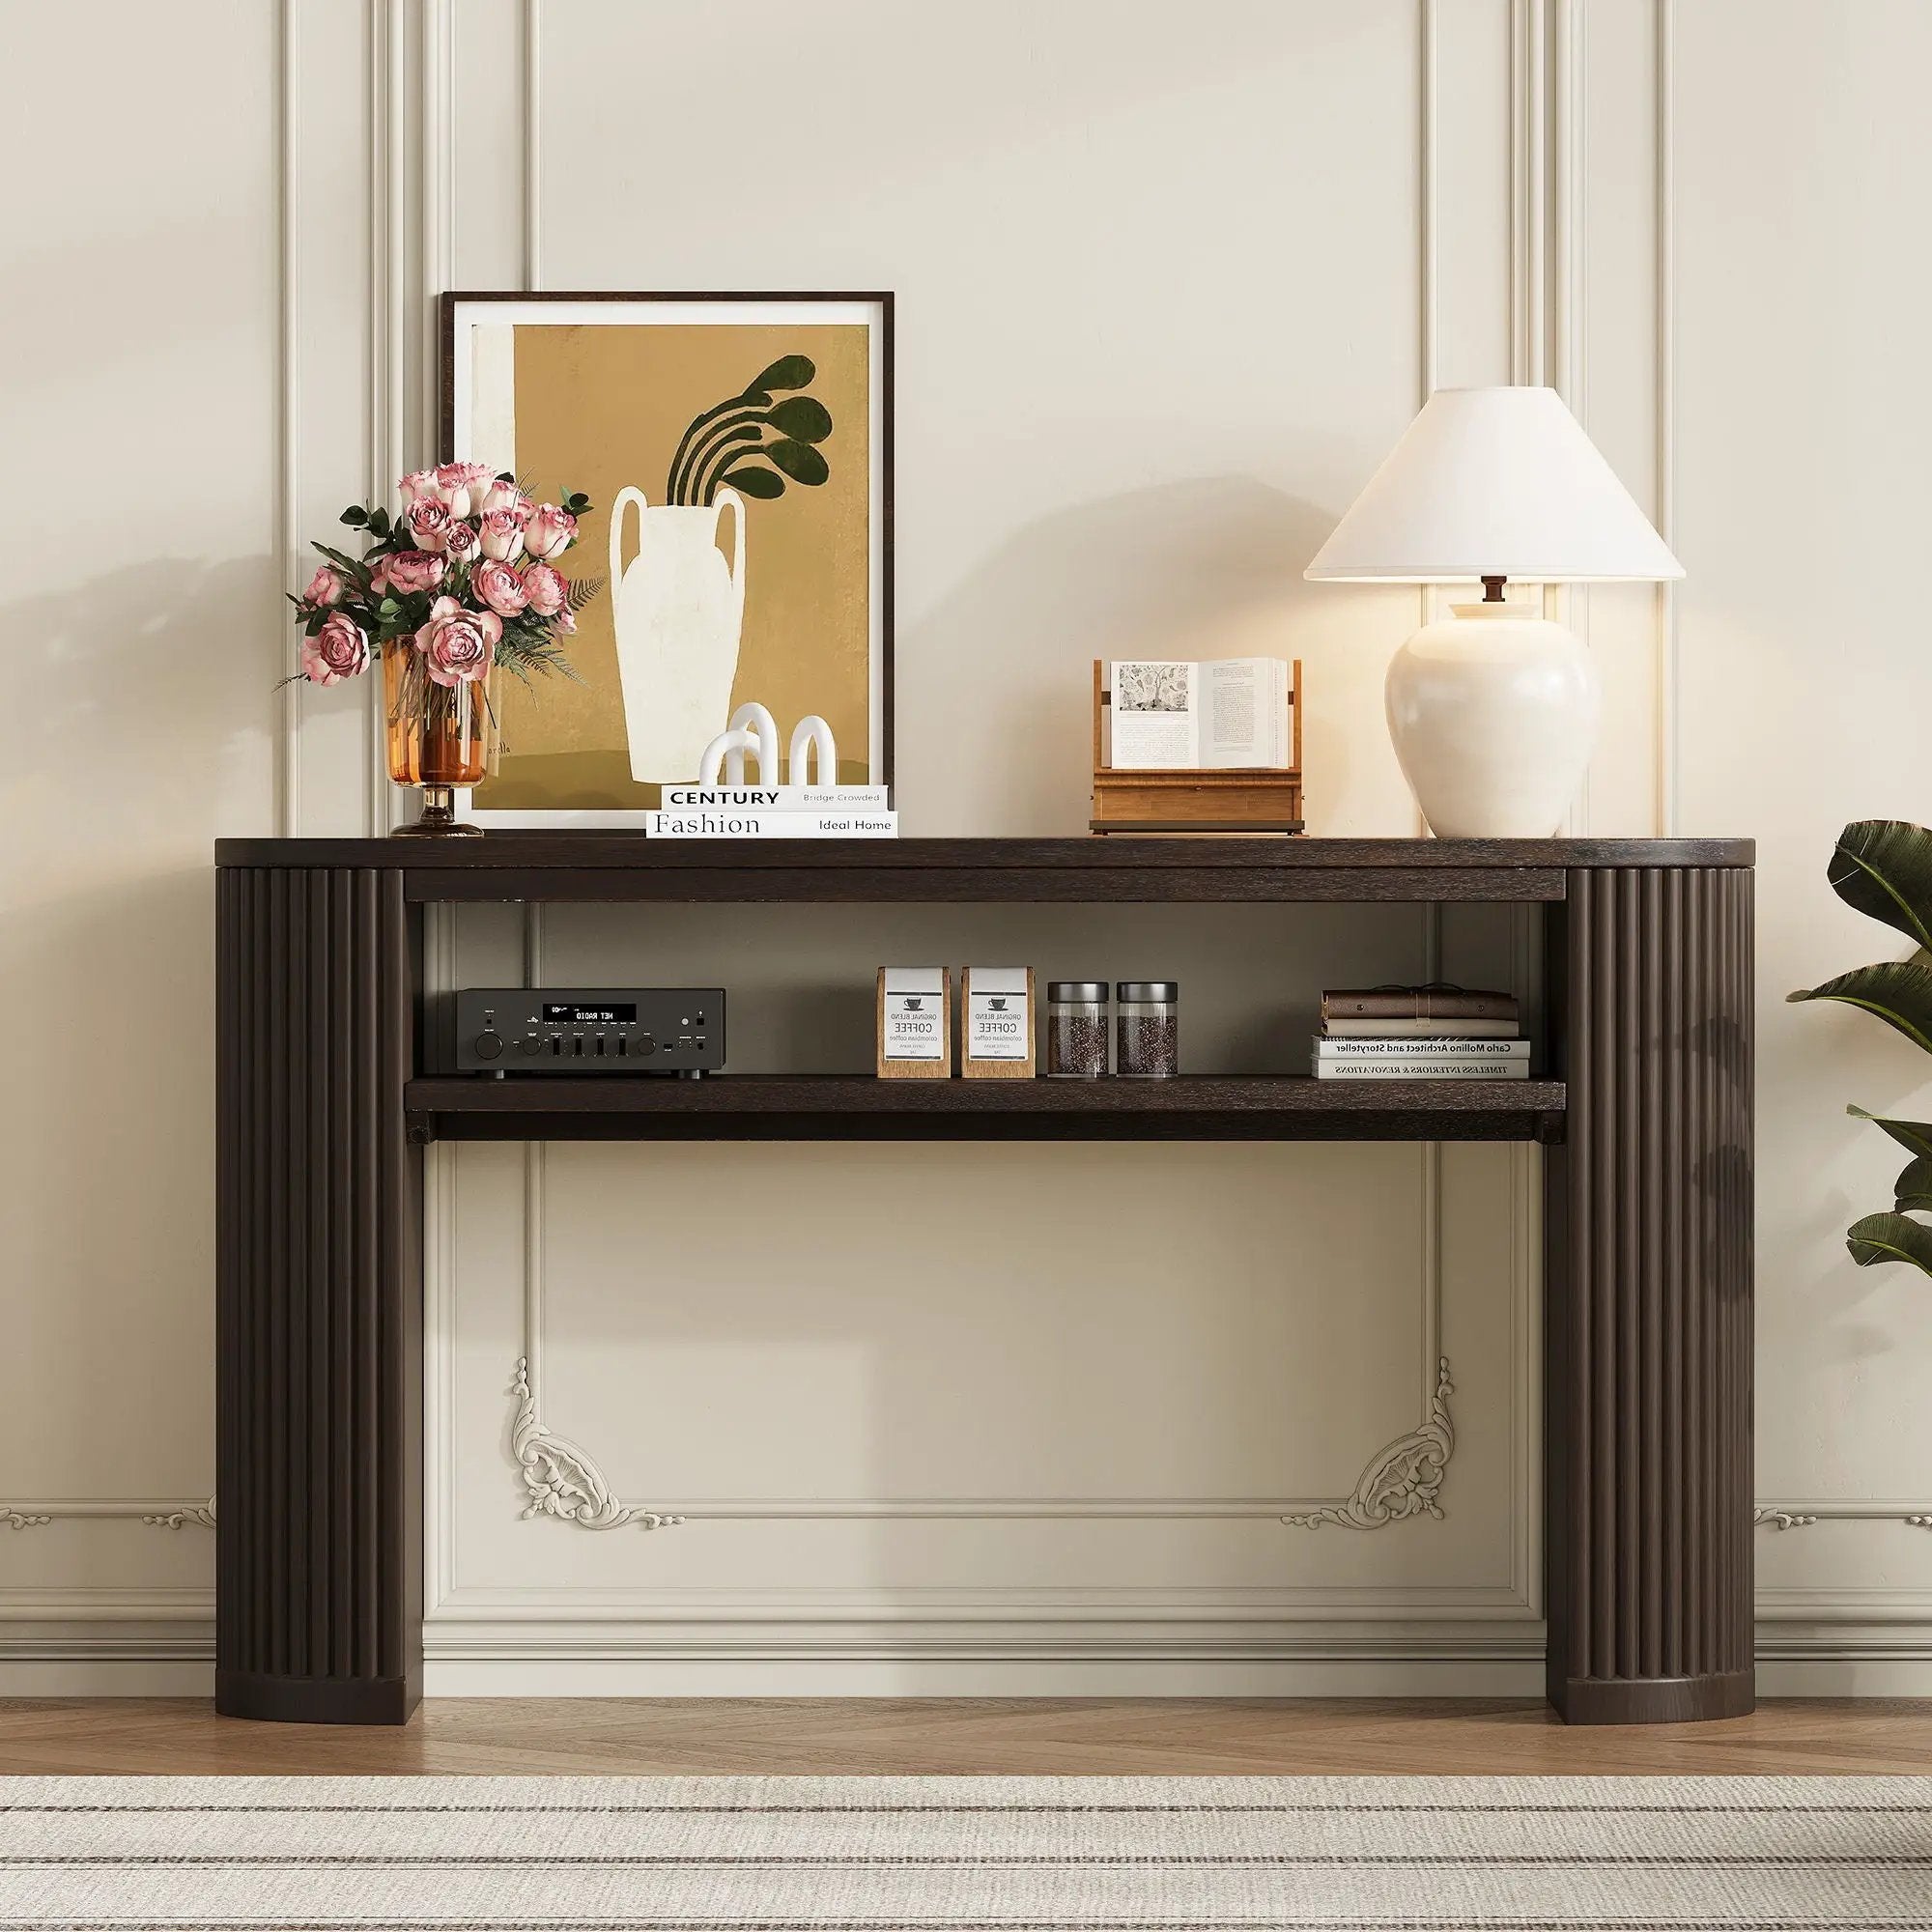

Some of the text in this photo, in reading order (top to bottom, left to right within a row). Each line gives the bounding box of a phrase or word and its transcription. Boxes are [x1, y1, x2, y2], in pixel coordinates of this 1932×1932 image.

[669, 792, 780, 805] CENTURY
[803, 793, 880, 803] Bridge Crowded
[654, 813, 760, 833] Fashion
[819, 820, 892, 830] Ideal Home
